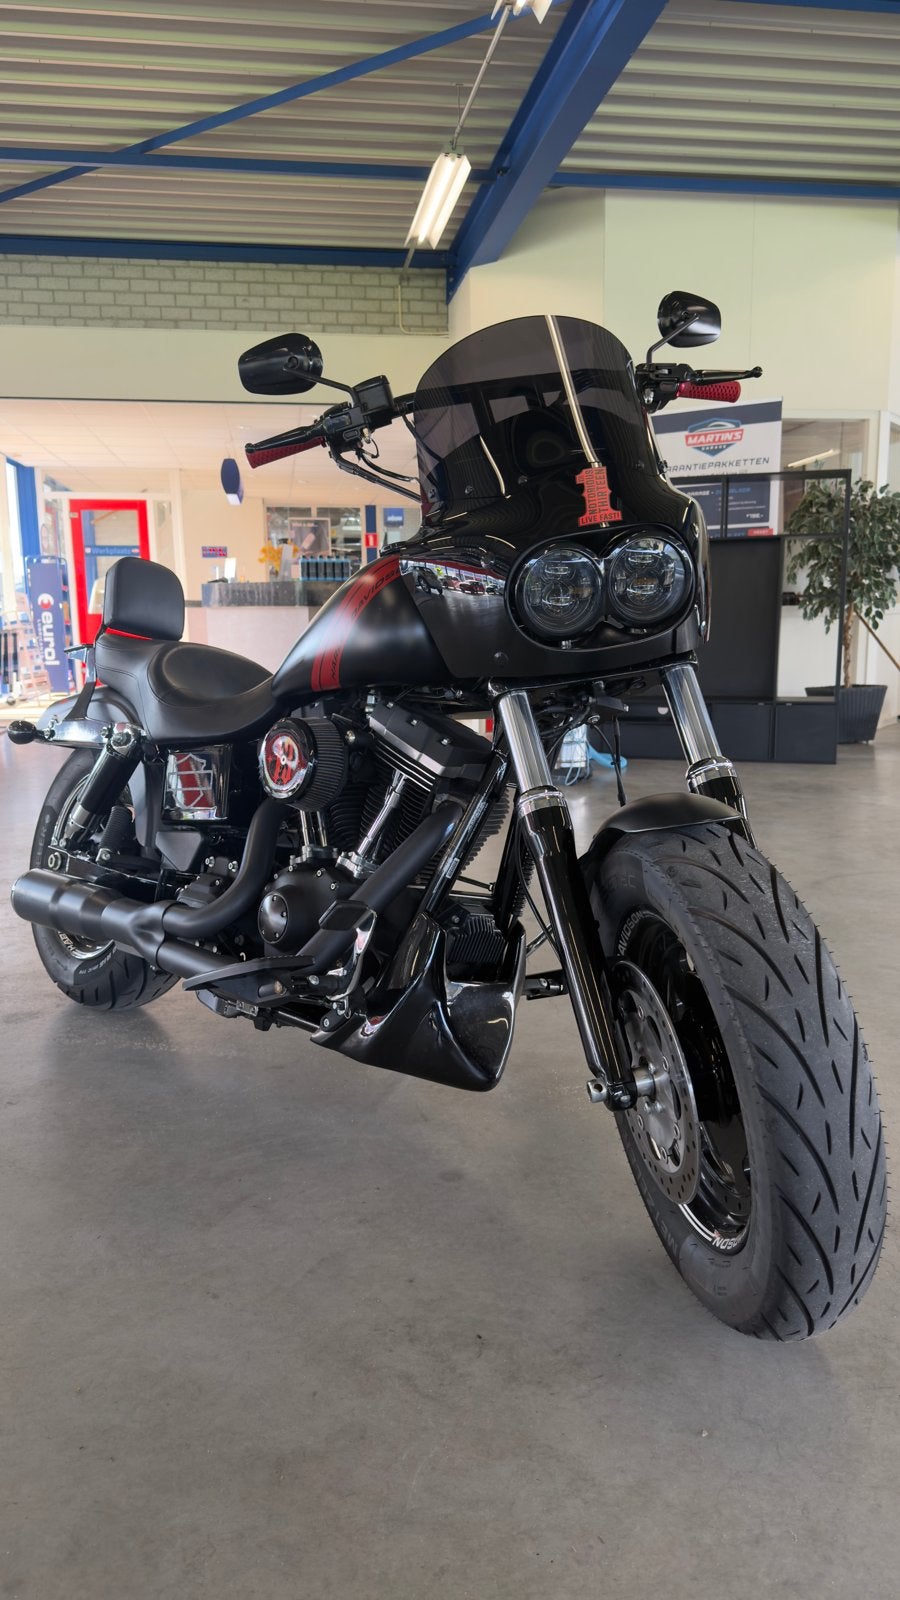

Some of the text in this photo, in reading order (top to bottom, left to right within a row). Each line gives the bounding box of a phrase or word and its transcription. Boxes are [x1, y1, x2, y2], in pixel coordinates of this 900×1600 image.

[687, 431, 743, 445] MARTIN'S
[666, 457, 770, 473] ARANTIEPAKKETTEN
[585, 470, 598, 515] NOTORIOUS
[594, 469, 609, 514] THIRTEEN
[581, 512, 620, 525] LIVE FAST!
[41, 612, 60, 666] eurol
[617, 910, 644, 956] AVIDSON
